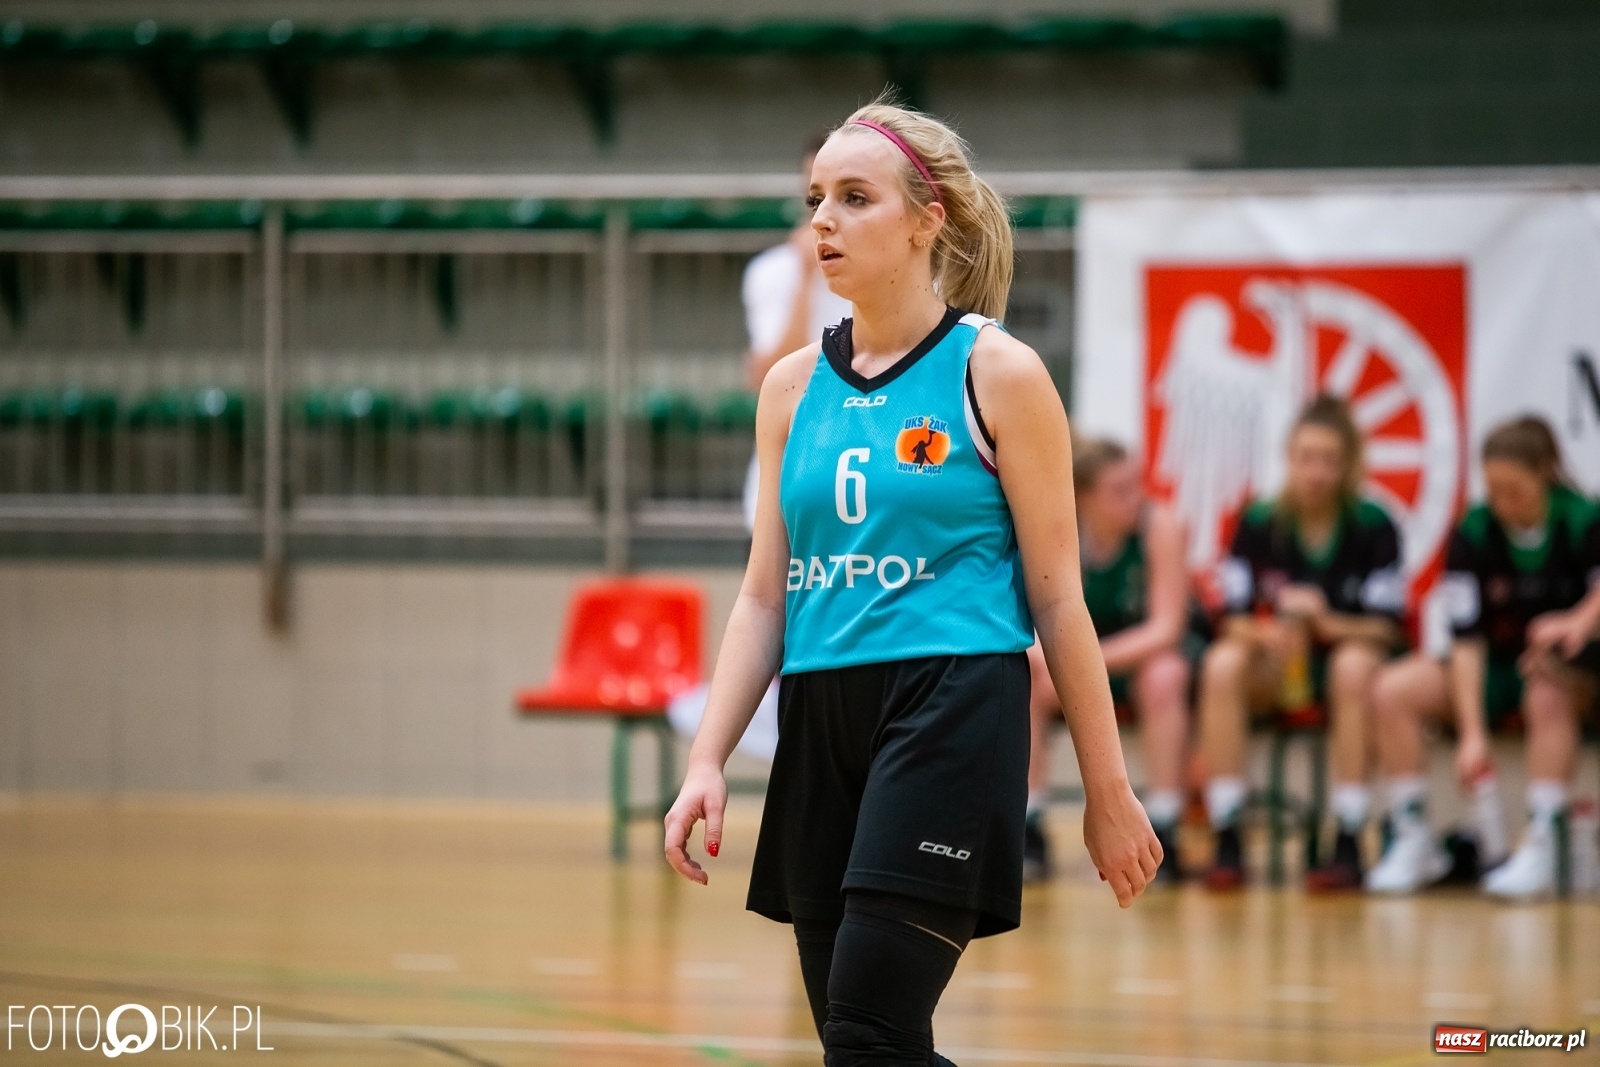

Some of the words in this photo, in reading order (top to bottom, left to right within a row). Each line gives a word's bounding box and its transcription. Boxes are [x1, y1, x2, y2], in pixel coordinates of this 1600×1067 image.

[843, 395, 888, 408] COLO
[904, 416, 924, 429] UKS
[928, 415, 947, 433] ŻAK
[897, 462, 918, 473] NOWY
[922, 465, 942, 476] SĄCZ
[835, 447, 870, 524] 6
[786, 554, 935, 592] BATPOL
[918, 841, 971, 860] COLO
